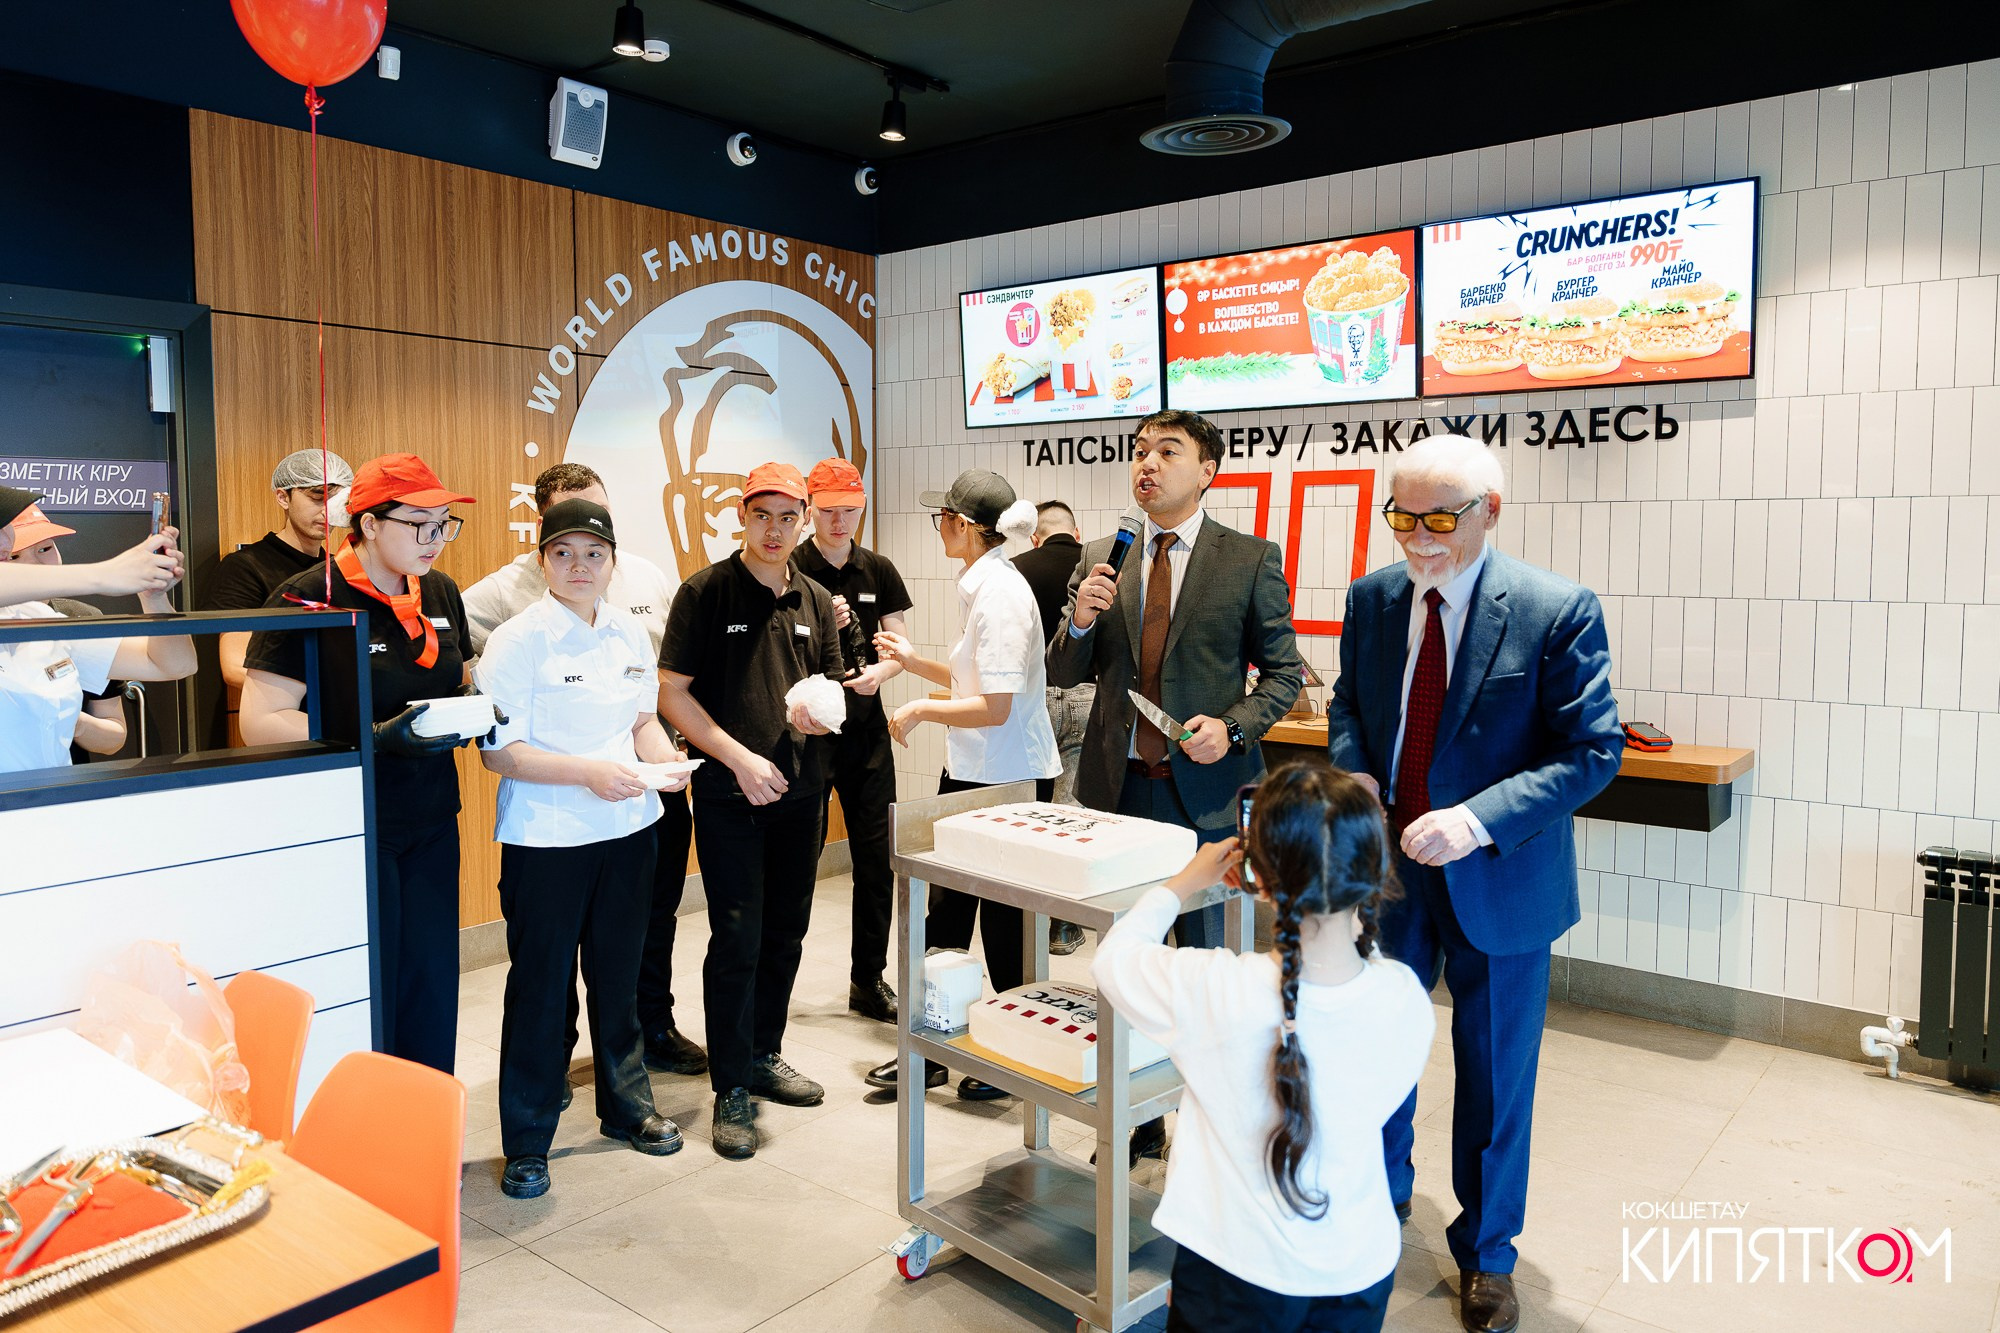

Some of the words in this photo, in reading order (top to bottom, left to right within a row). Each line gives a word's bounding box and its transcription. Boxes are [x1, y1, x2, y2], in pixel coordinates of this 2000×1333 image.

[1516, 207, 1680, 258] CRUNCHERS!
[1567, 256, 1583, 267] БАР
[1587, 262, 1613, 273] ВСЕГО
[1615, 261, 1626, 269] ЗА
[1662, 259, 1694, 277] МАЙО
[1556, 276, 1595, 291] БУРГЕР
[1651, 271, 1702, 289] КРАНЧЕР
[986, 289, 1034, 305] СЭНДВИЧТЕР
[1212, 284, 1258, 301] БАСКЕТТЕ
[1460, 282, 1507, 299] БАРБЕКЮ
[1551, 286, 1598, 303] КРАНЧЕР
[1460, 292, 1504, 309] КРАНЧЕР
[1214, 301, 1280, 320] ВОЛШЕБСТВО
[526, 272, 633, 415] WORLD
[641, 229, 789, 282] FAMOUS
[1198, 322, 1206, 334] В
[1207, 318, 1252, 333] КАЖДОМ
[1253, 312, 1299, 329] БАСКЕТЕ!
[1220, 425, 1289, 459] ЕРУ
[1524, 404, 1680, 450] ЗДЕСЬ
[89, 464, 133, 482] КІРУ
[94, 488, 147, 508] ВХОД
[630, 605, 653, 615] KFC
[727, 624, 748, 634] KFC
[368, 643, 387, 653] FC
[564, 675, 584, 683] KFC
[1021, 990, 1089, 1011] KFC
